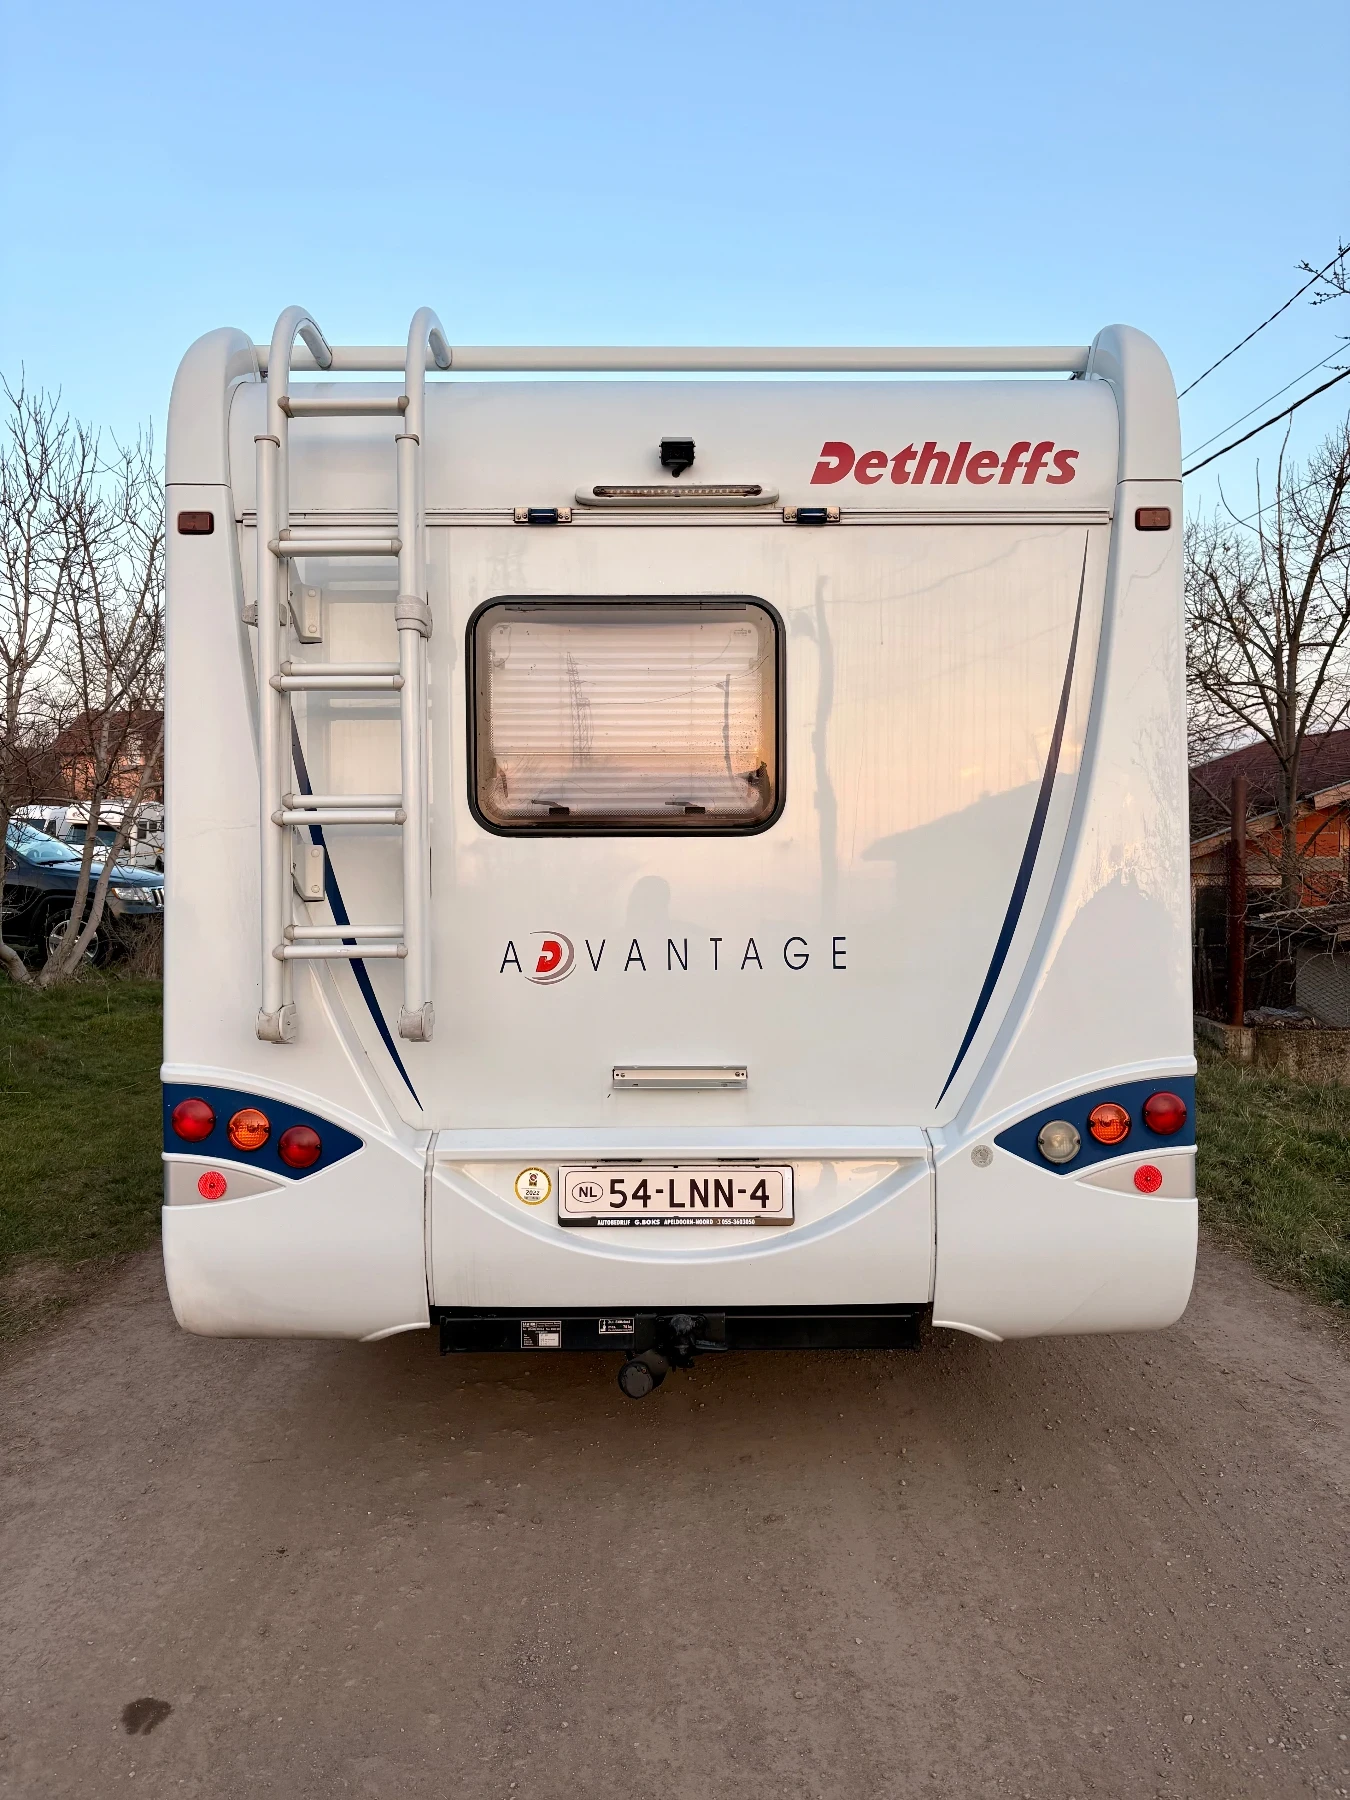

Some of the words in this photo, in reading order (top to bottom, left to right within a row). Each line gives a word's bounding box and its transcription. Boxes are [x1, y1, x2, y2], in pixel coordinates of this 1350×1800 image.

[809, 441, 1079, 485] Dethleffs
[499, 936, 848, 974] ADVANTAGE
[578, 1186, 598, 1198] NL
[609, 1178, 770, 1208] 54-LNN-4
